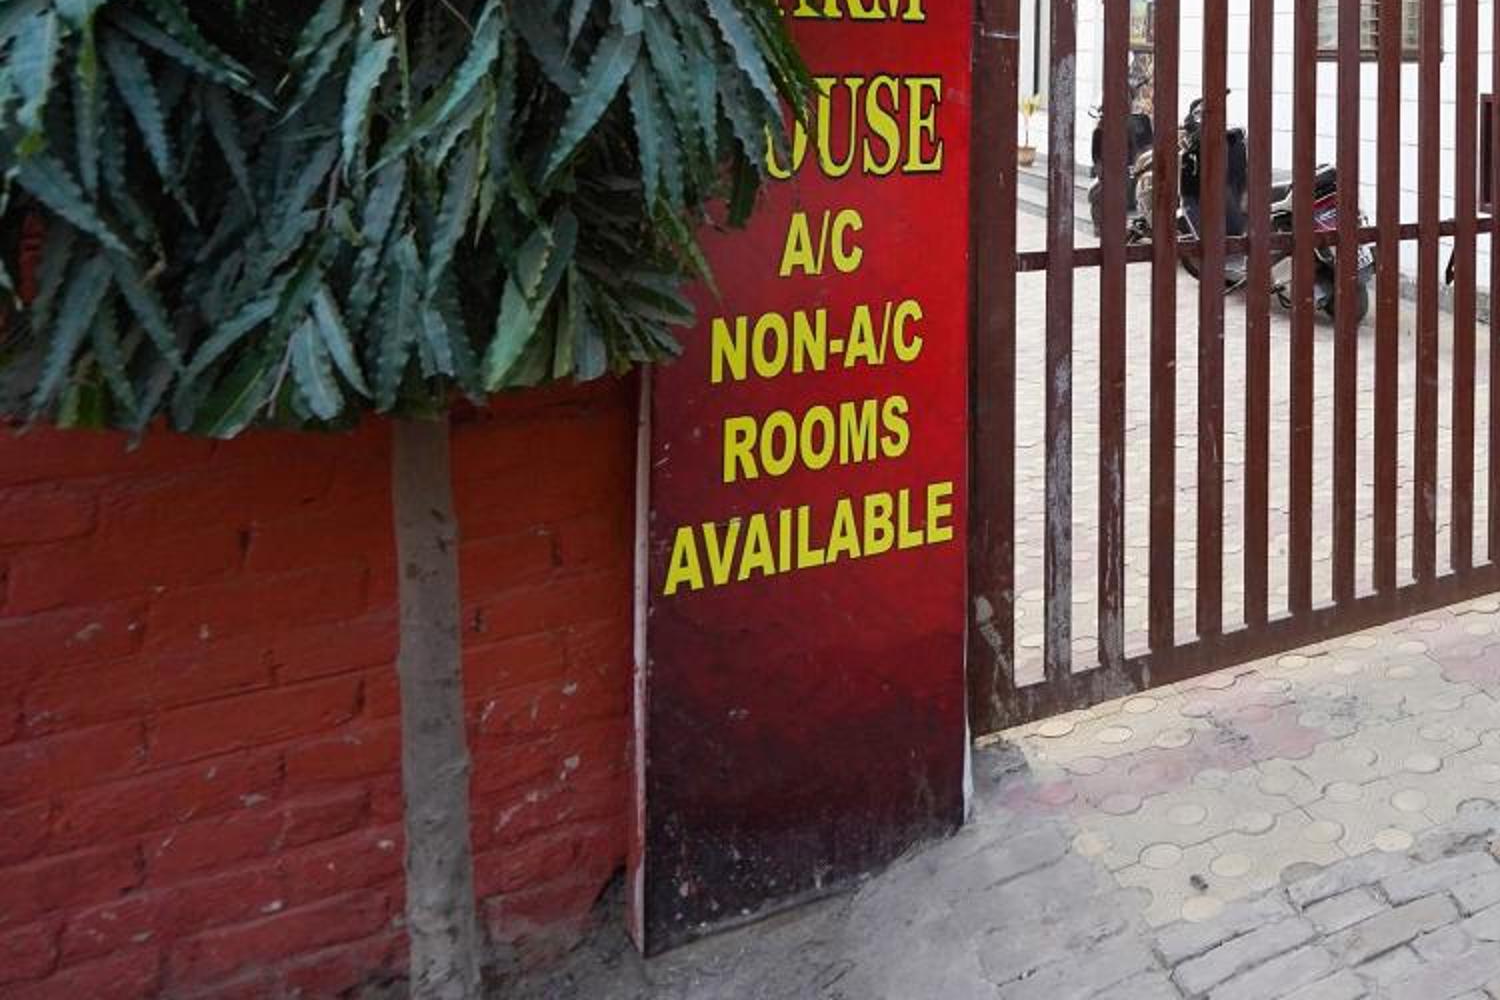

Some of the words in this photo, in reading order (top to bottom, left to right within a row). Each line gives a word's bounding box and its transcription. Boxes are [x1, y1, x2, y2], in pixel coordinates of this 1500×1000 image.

[765, 74, 944, 180] OUSE
[779, 208, 864, 277] A/C
[710, 299, 924, 384] NON-A/C
[722, 395, 910, 483] ROOMS
[663, 481, 954, 597] AVAILABLE
